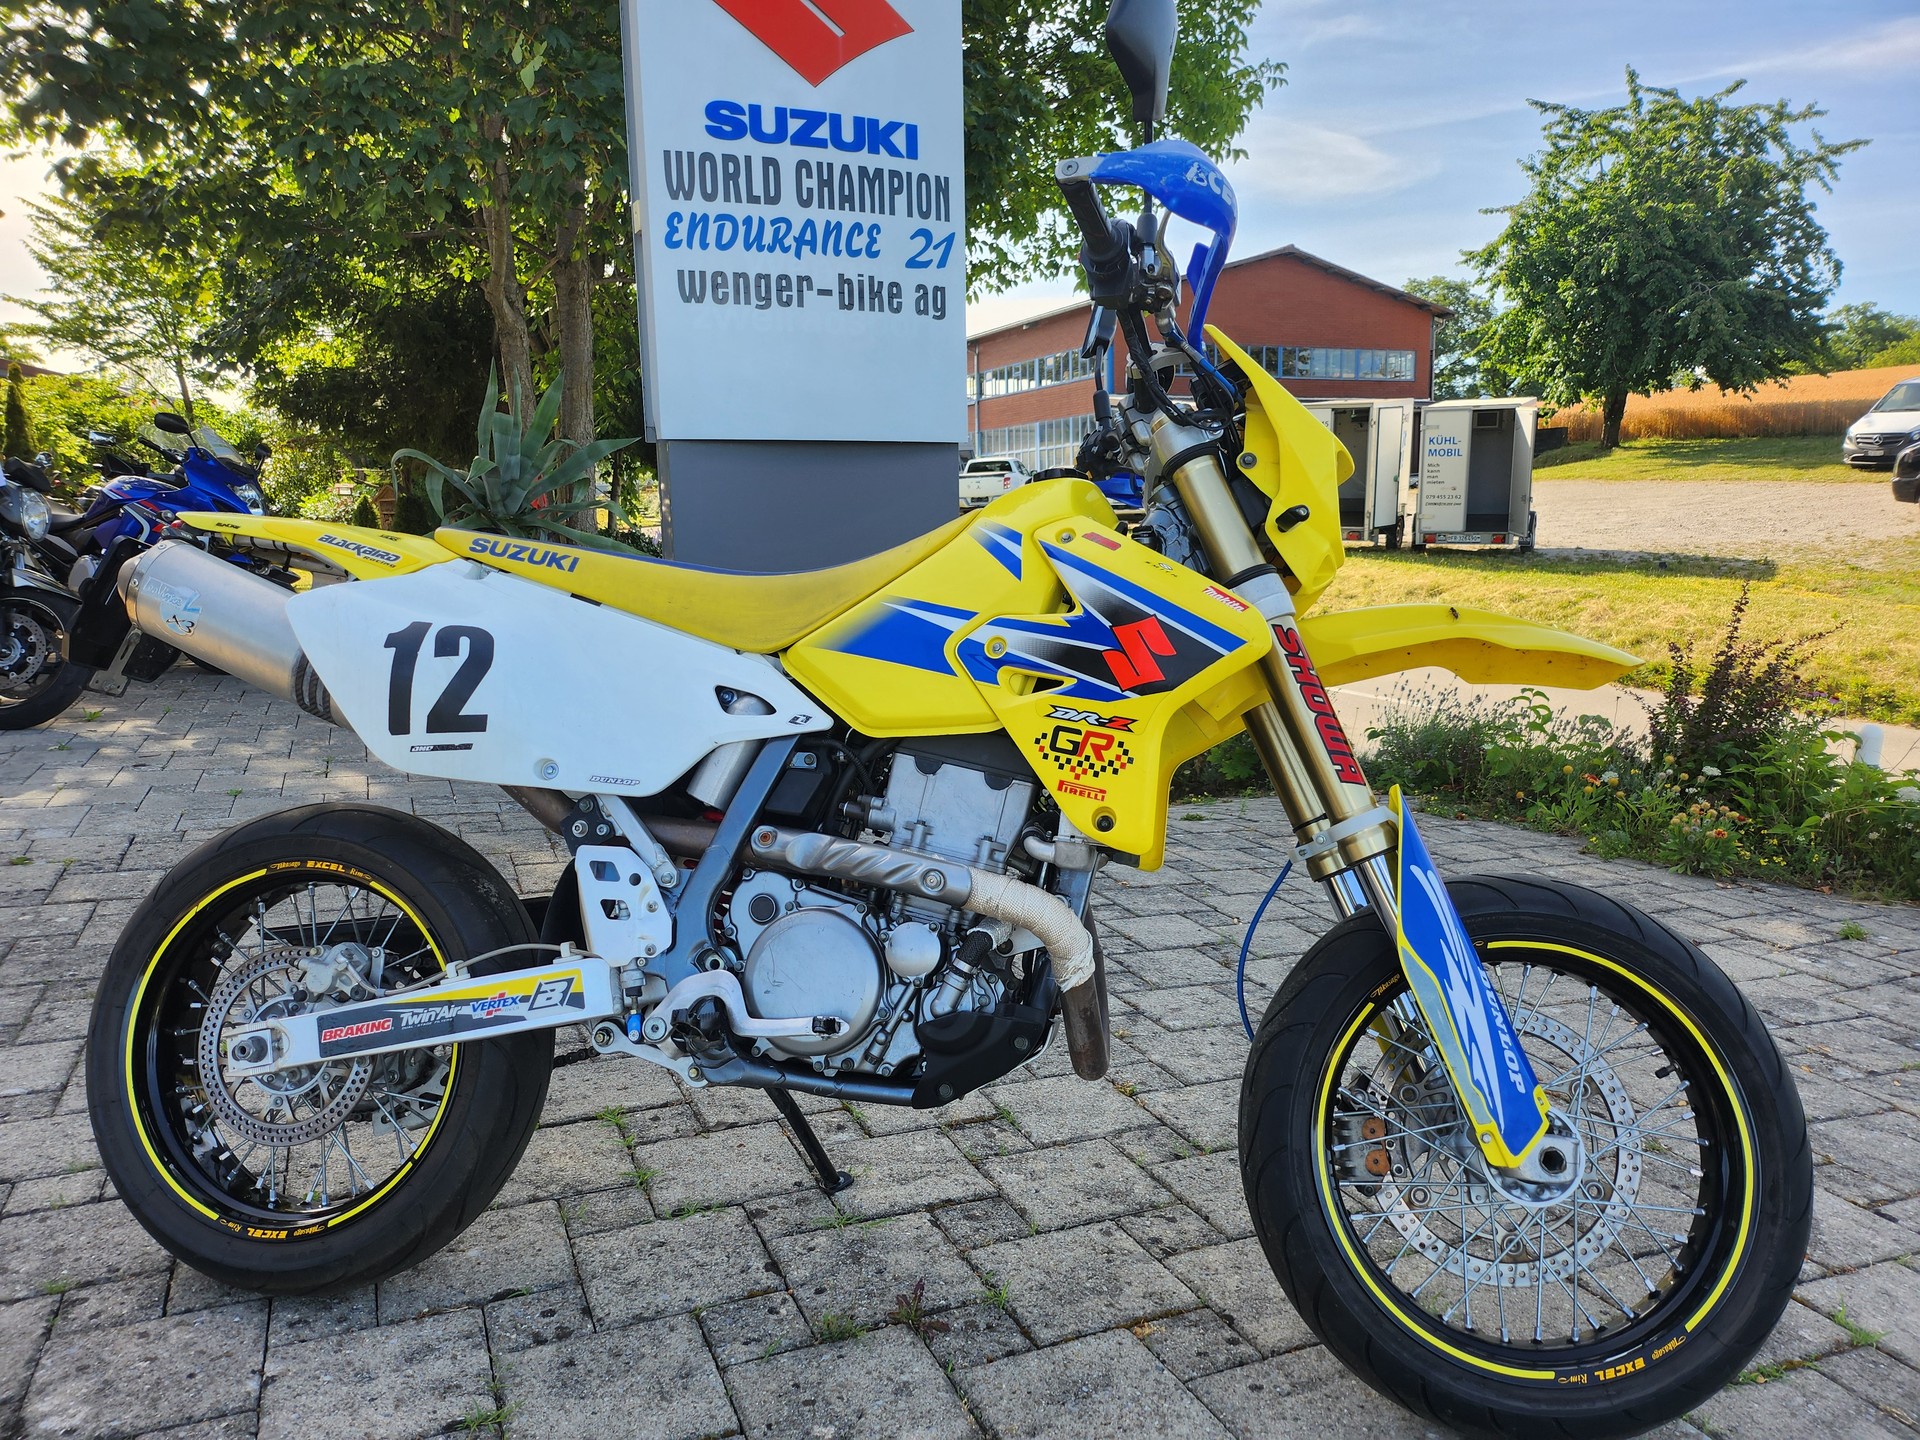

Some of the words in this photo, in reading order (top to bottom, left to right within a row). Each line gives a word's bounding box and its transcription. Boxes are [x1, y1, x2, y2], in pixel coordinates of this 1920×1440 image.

[704, 100, 919, 160] SUZUKI
[663, 150, 782, 206] WORLD
[795, 159, 950, 222] CHAMPION
[664, 211, 882, 260] ENDURANCE
[904, 227, 956, 269] 21
[677, 269, 903, 315] wenger-bike
[915, 283, 947, 320] ag
[1427, 448, 1463, 457] MOBIL
[1428, 434, 1462, 446] KÜHL-
[469, 537, 580, 573] SUZUKI
[1203, 586, 1248, 612] makita
[384, 621, 495, 736] 12
[1271, 623, 1367, 786] SHOWA
[1045, 704, 1139, 733] DR-Z
[1049, 725, 1115, 763] GR
[590, 775, 641, 787] DUNLOP
[1057, 779, 1106, 802] PIRELLI
[306, 860, 346, 873] EXCEL
[470, 995, 521, 1013] VERTEX
[321, 1017, 393, 1044] BRAKING
[1477, 965, 1527, 1095] DUNLOP
[246, 1227, 289, 1239] EXCEL
[1557, 1373, 1589, 1385] Rim
[1594, 1357, 1646, 1381] EXCEL
